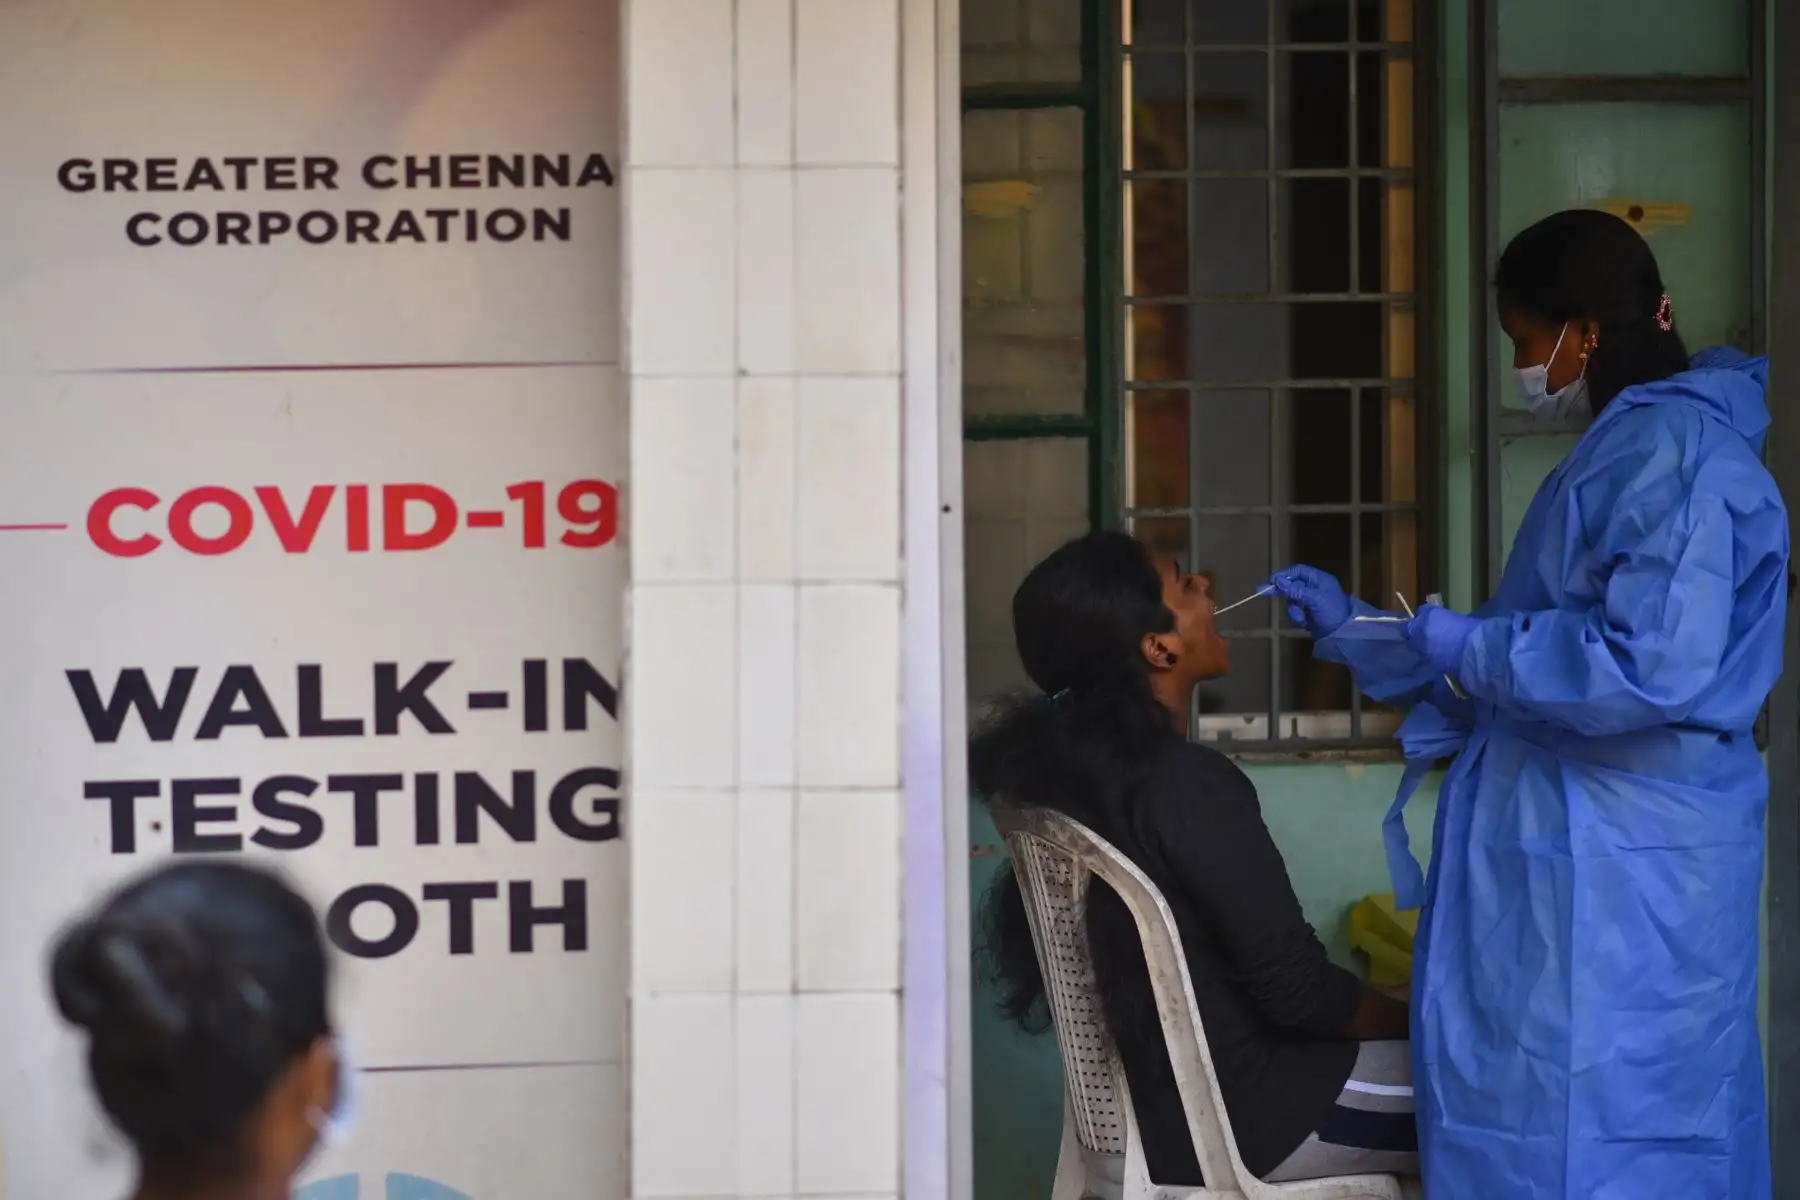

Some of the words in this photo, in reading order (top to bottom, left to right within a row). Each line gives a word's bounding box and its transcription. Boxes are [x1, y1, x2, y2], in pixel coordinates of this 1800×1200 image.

[57, 155, 339, 193] GREATER
[361, 152, 614, 188] CHENNA
[125, 207, 571, 246] CORPORATION
[86, 479, 617, 557] COVID-19
[65, 657, 620, 743] WALK-IN
[84, 766, 621, 853] TESTING
[326, 879, 588, 958] OTH
